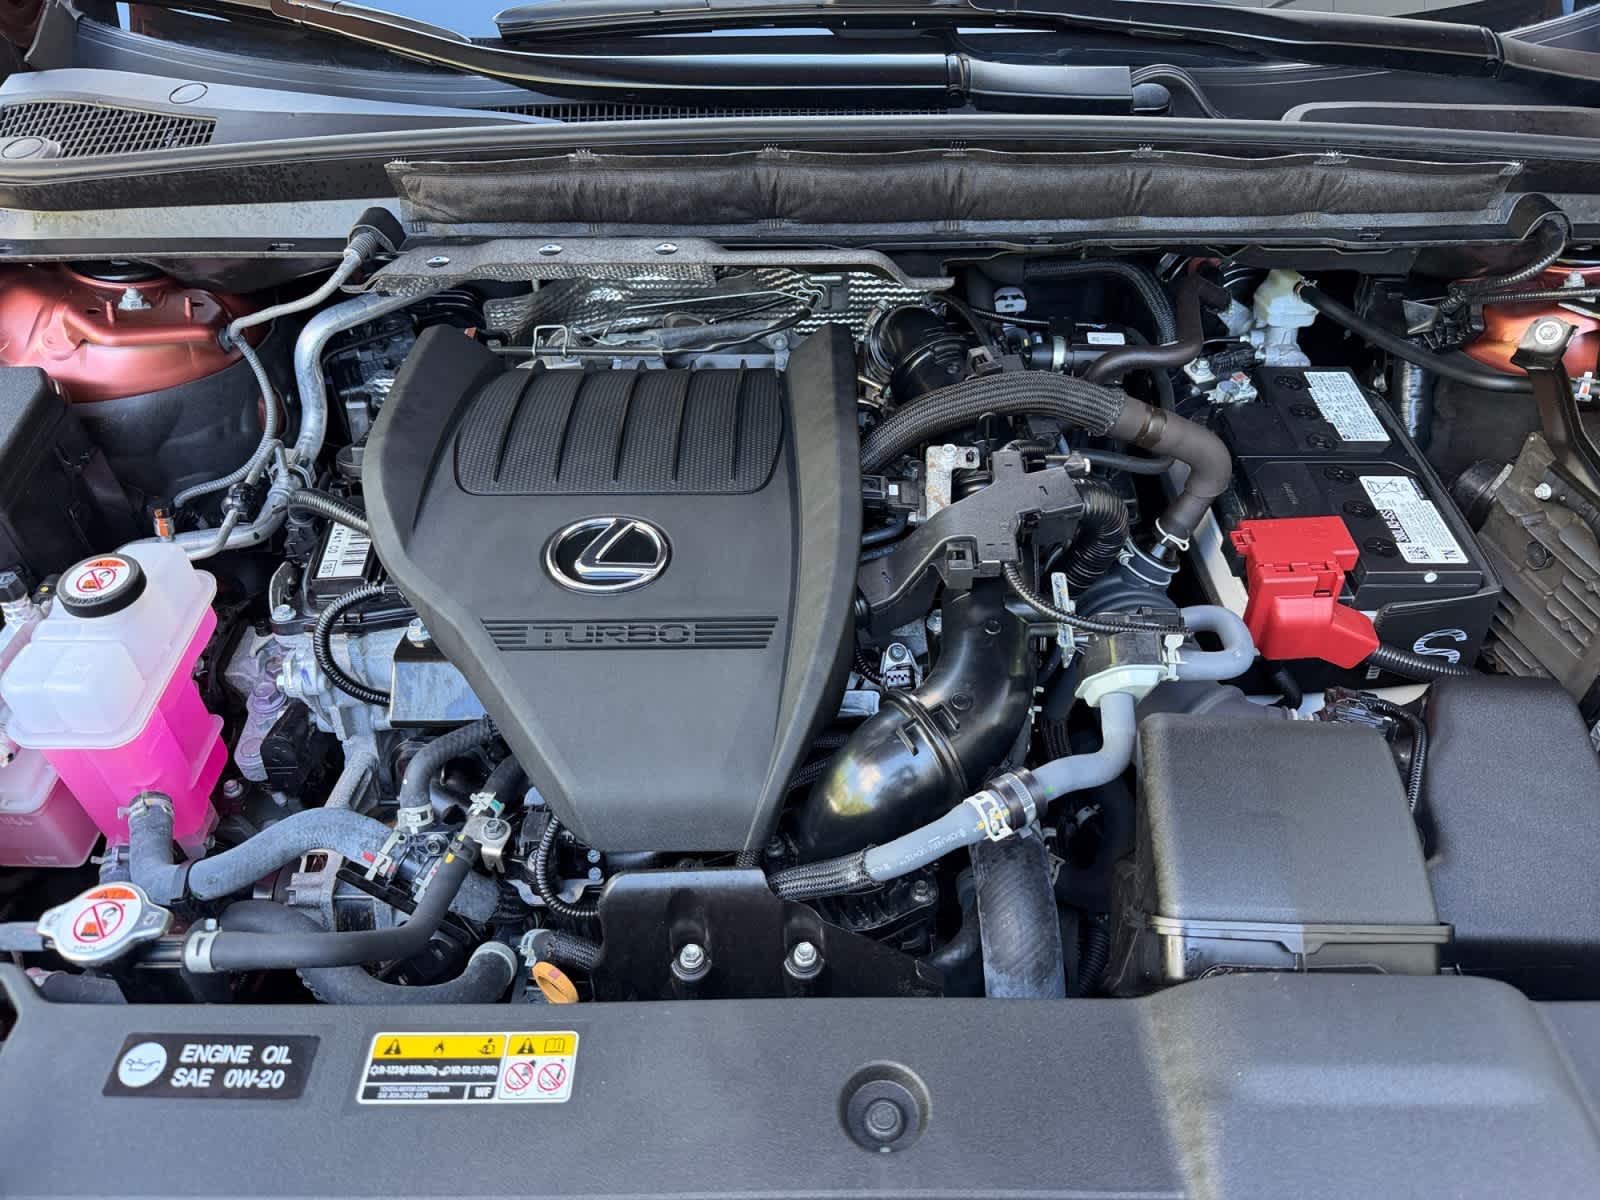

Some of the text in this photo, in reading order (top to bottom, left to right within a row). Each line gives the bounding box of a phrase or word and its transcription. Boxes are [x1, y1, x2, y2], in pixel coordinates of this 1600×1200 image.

[531, 623, 691, 644] TURBO
[179, 1043, 293, 1065] ENGINE OIL
[170, 1067, 286, 1089] SAE 0W-20
